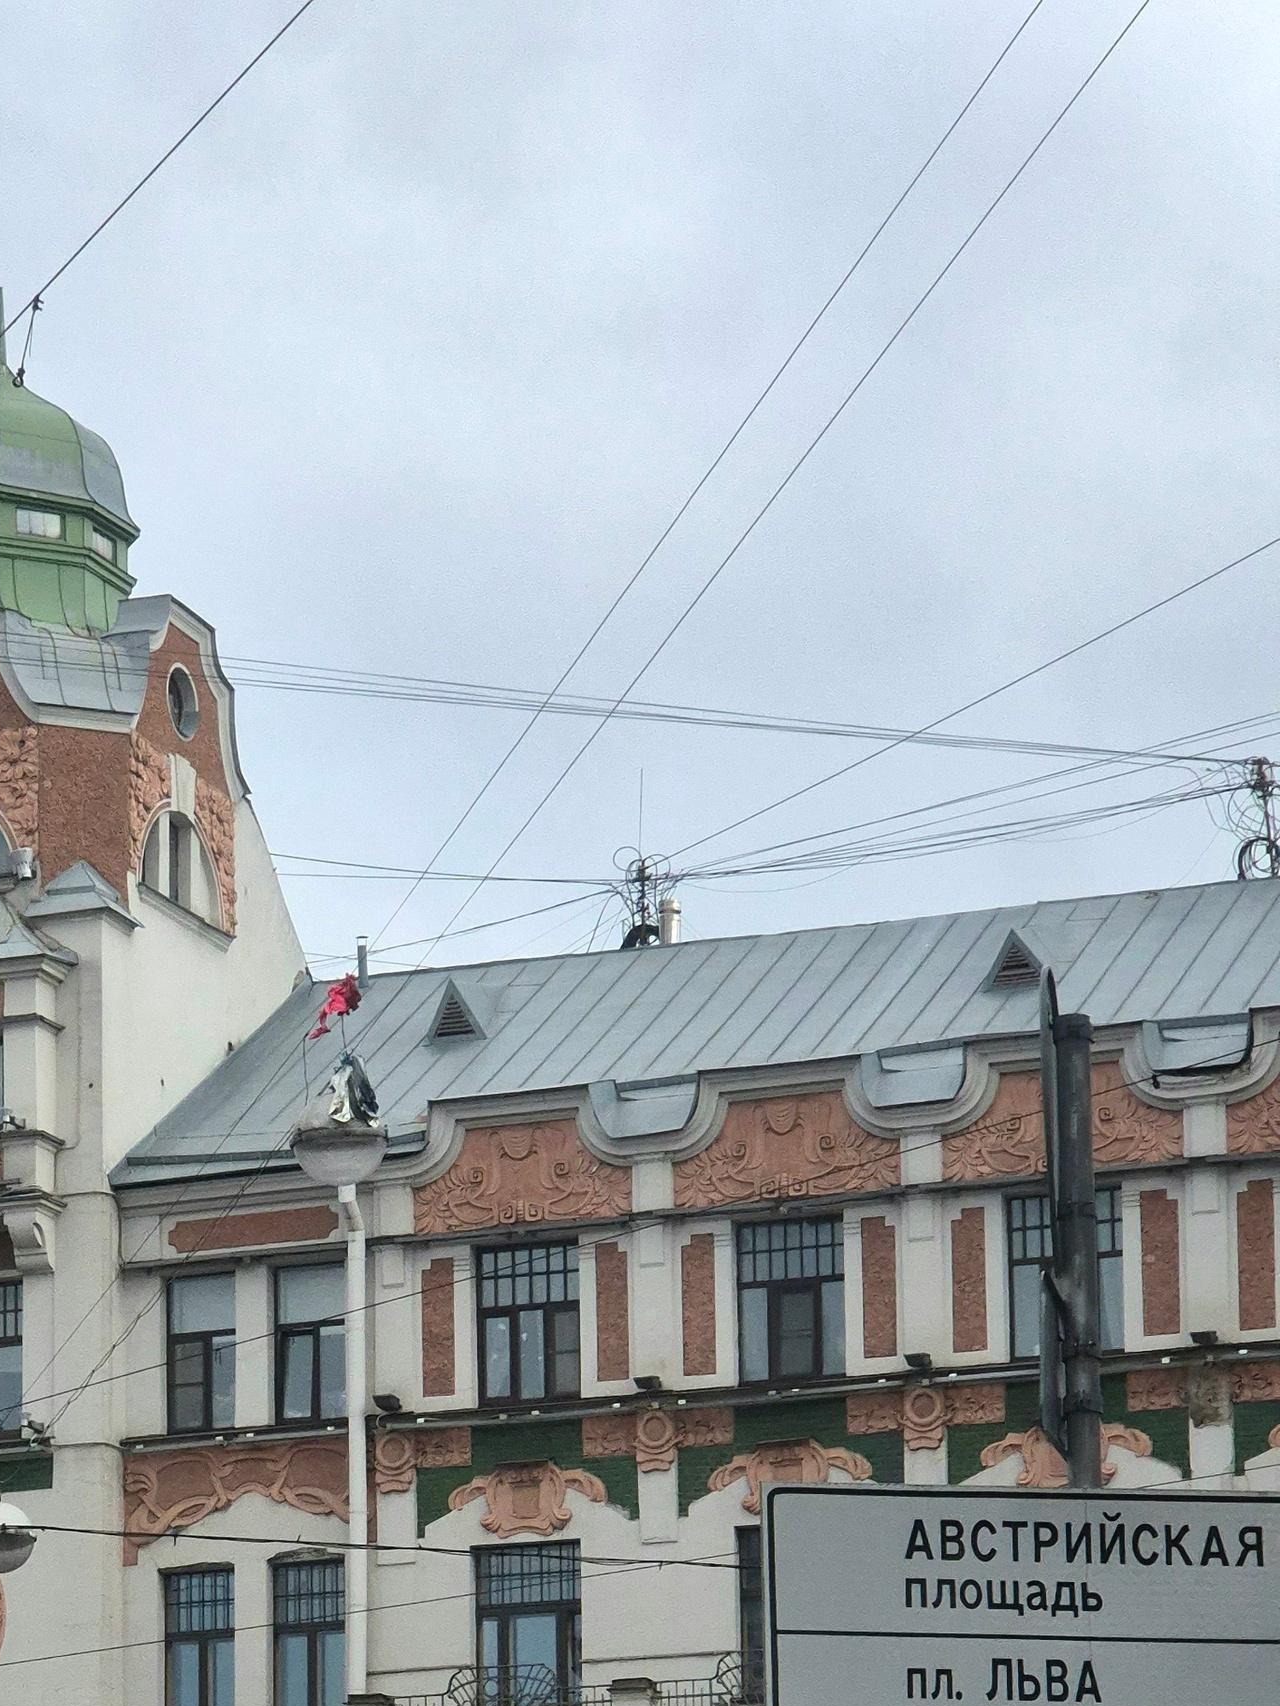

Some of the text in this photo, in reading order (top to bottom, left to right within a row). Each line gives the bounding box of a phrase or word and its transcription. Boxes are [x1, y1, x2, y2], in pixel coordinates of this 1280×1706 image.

[904, 1511, 1265, 1568] АВСТРИЙСКАЯ
[904, 1577, 1104, 1618] площадь
[906, 1657, 1103, 1704] пл. ЛЬВА
